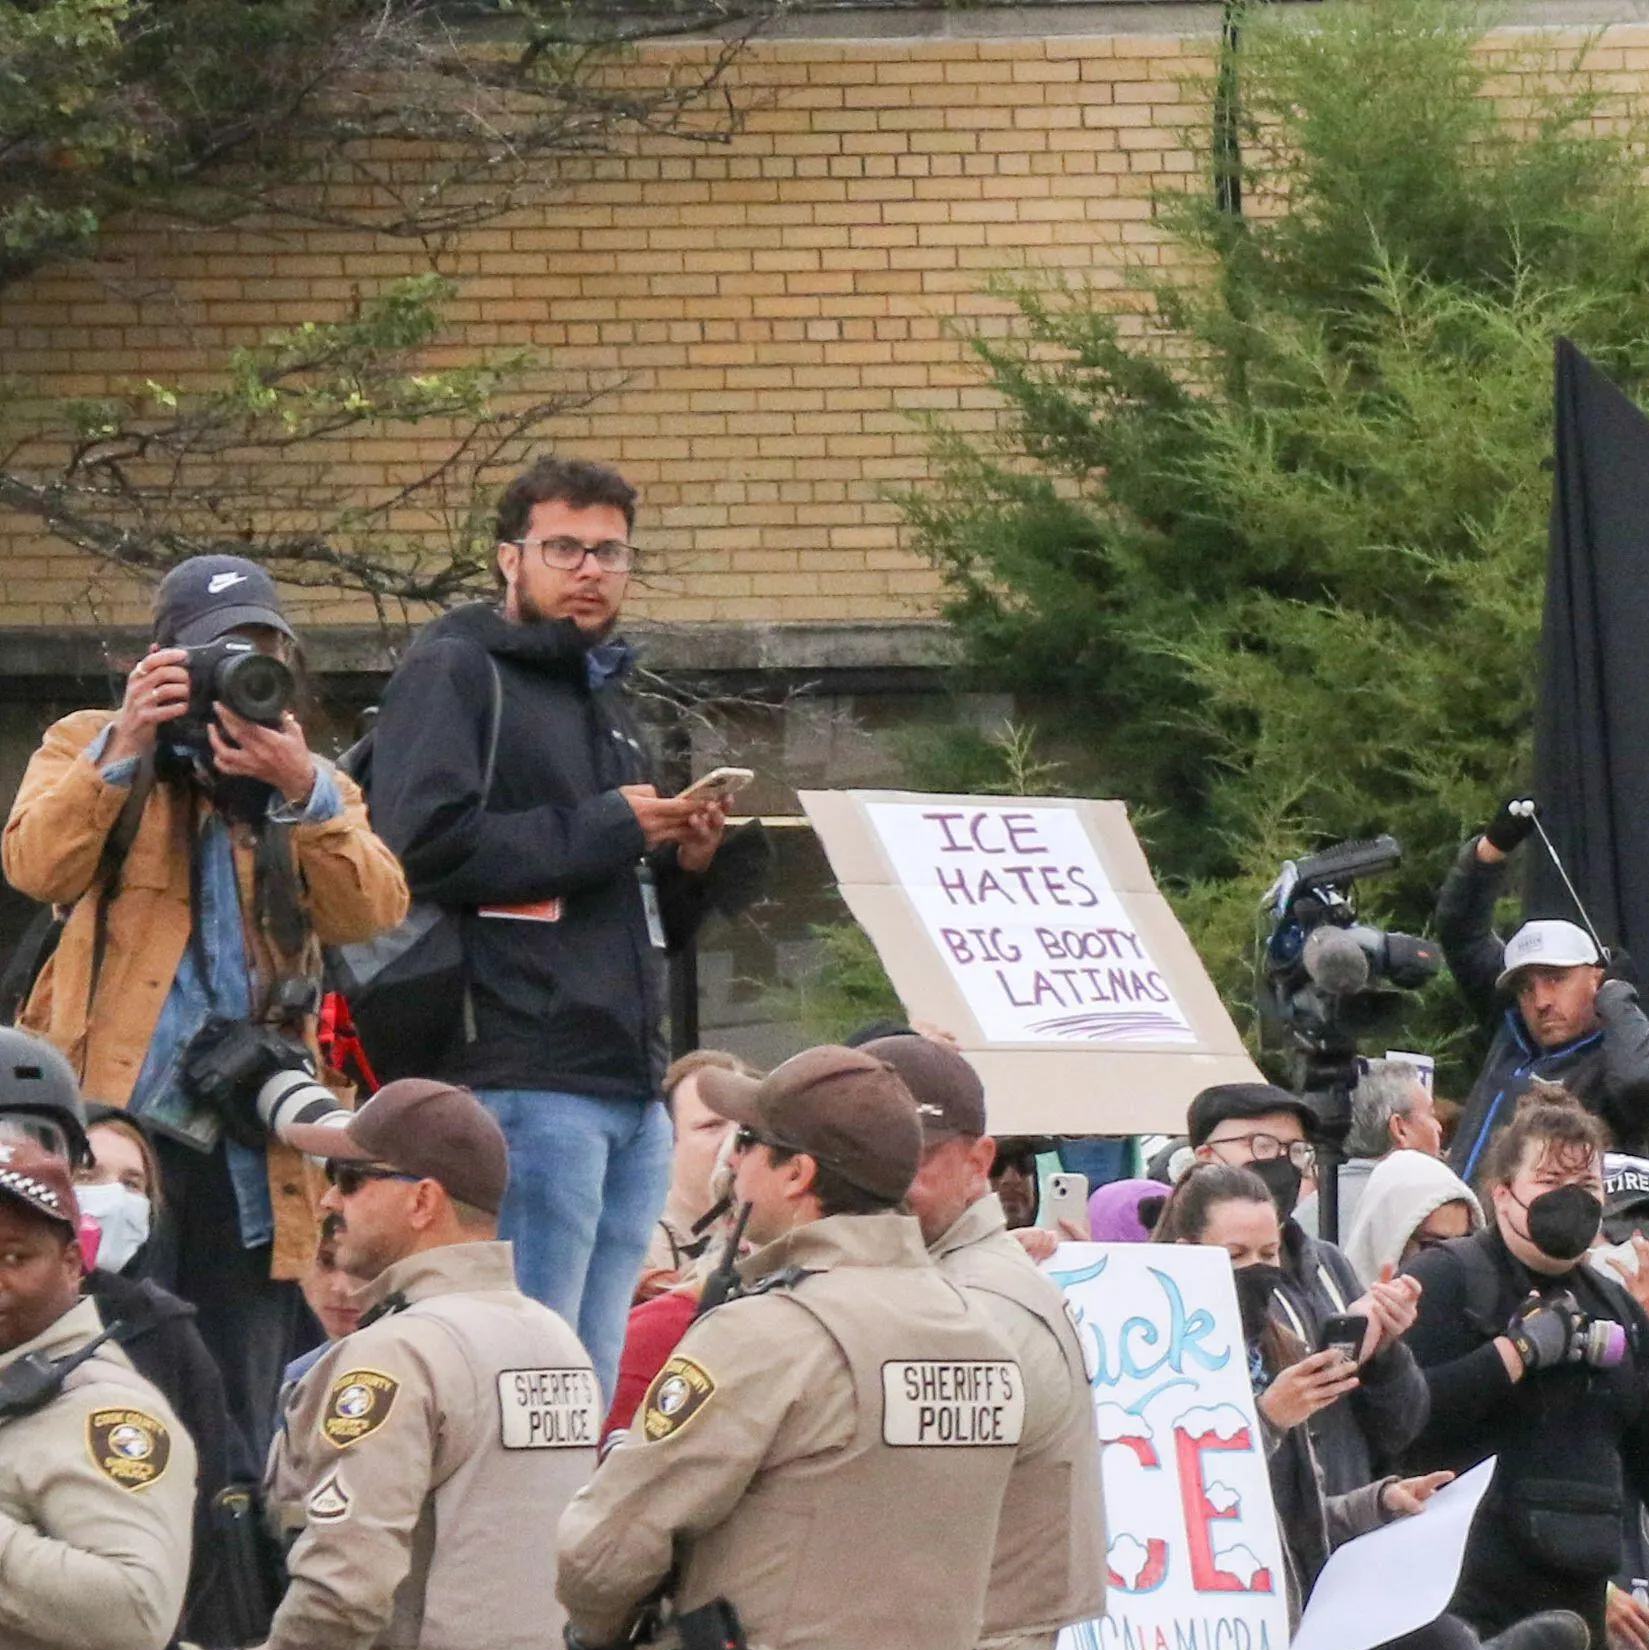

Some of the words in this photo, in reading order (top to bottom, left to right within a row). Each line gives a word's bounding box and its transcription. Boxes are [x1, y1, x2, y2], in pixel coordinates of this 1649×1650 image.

[922, 812, 1049, 855] ICE
[935, 866, 1099, 908] HATES
[940, 927, 1022, 964] BIG
[1035, 927, 1144, 960] BOOTY
[996, 967, 1169, 1007] LATINAS
[903, 1365, 1014, 1402] SHERIFF'S
[529, 1408, 591, 1444] POLICE
[918, 1406, 1005, 1442] POLICE
[1098, 1401, 1276, 1596] CE
